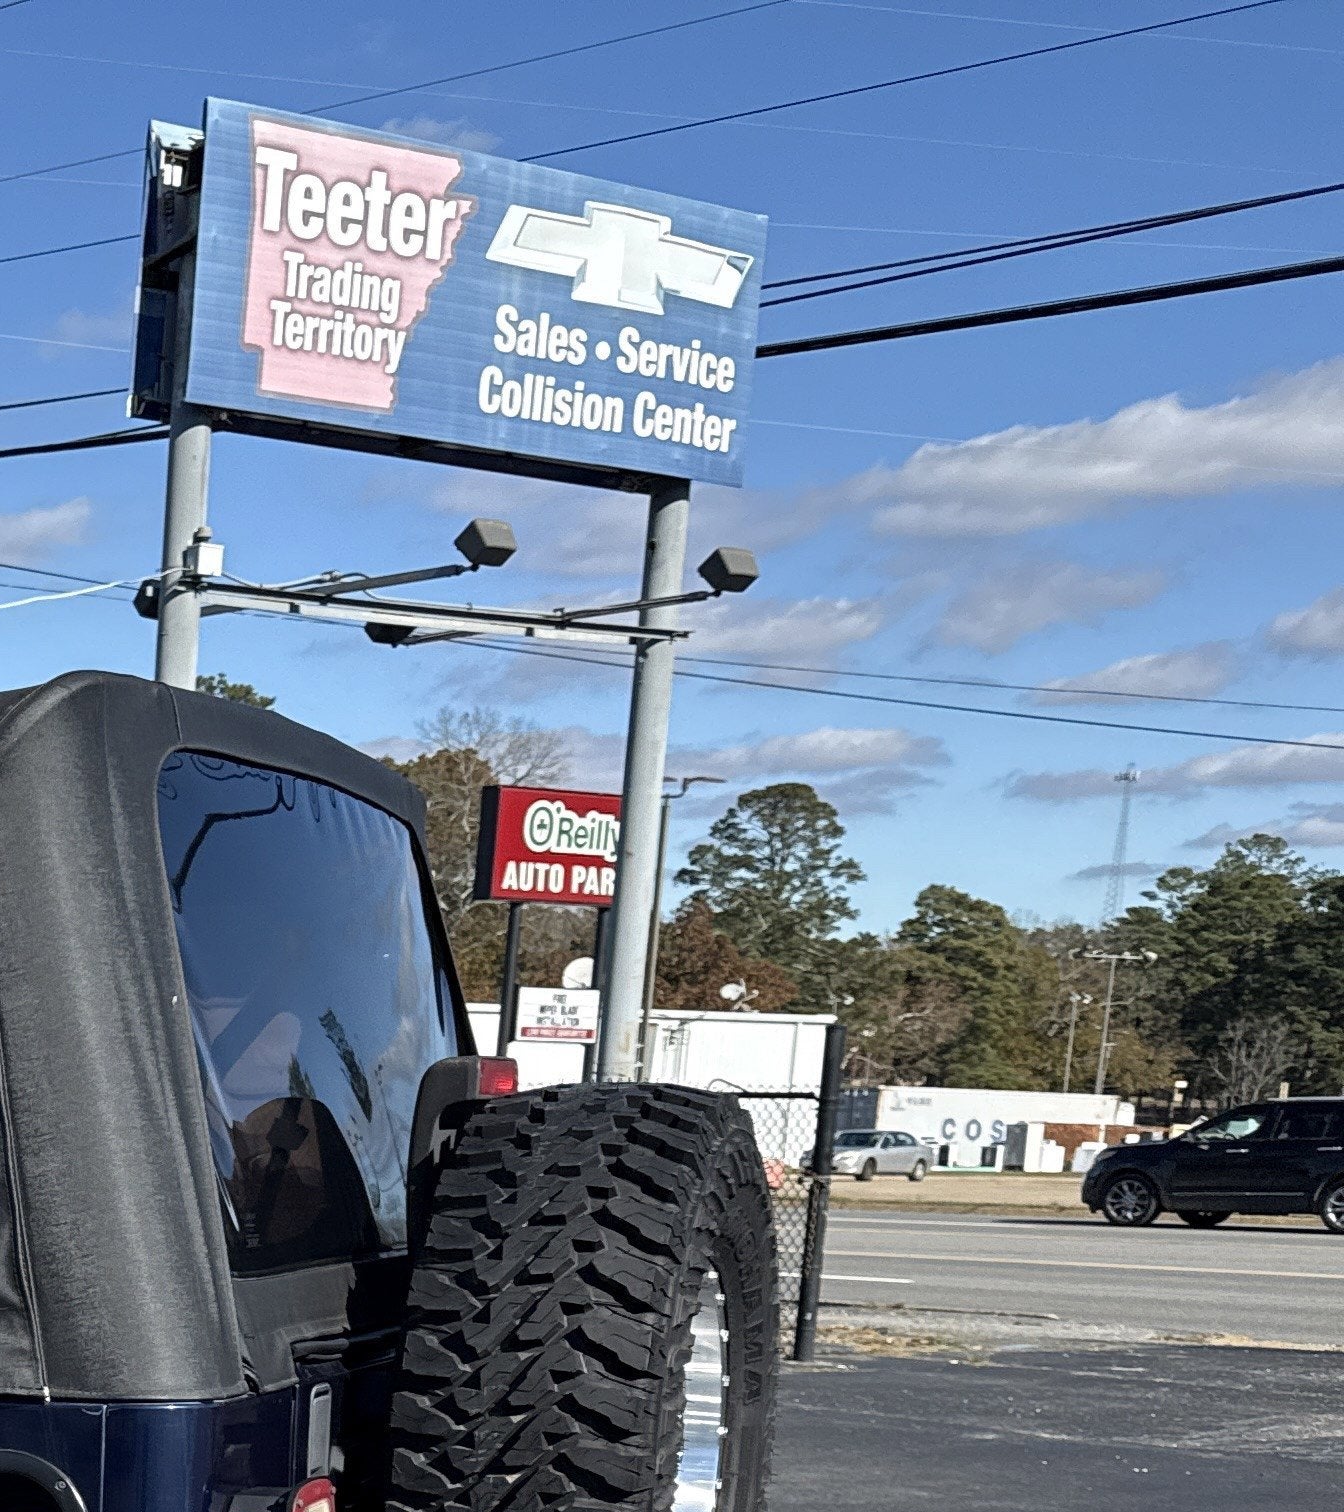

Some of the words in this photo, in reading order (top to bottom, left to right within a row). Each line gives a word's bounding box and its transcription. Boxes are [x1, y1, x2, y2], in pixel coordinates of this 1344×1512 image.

[255, 145, 461, 261] Teeter
[283, 250, 402, 324] Trading
[269, 301, 406, 374] Territory
[493, 304, 587, 366] Sales
[616, 326, 736, 394] Service
[478, 366, 622, 433] Collision
[632, 389, 737, 453] Center
[501, 859, 565, 894] AUTO
[570, 864, 616, 897] PAR
